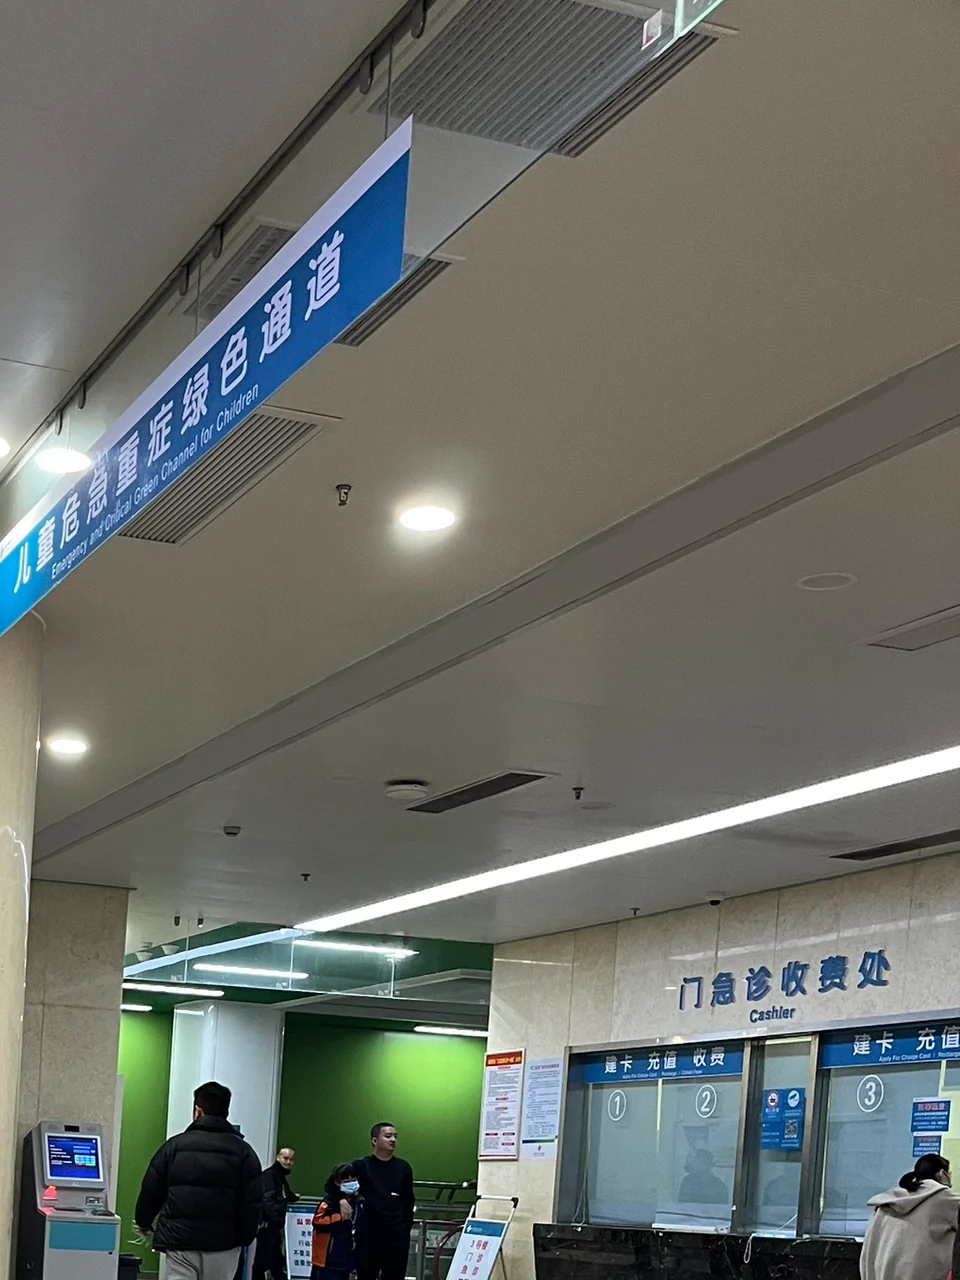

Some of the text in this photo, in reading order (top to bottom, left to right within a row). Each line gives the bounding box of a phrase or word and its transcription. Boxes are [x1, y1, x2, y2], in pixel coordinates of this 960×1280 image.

[14, 230, 345, 593] 儿童危急重症绿色通道
[52, 384, 259, 579] Emergency and Critical Green Channel for Children
[679, 950, 891, 1010] 门急诊收费处
[749, 1005, 796, 1023] Cashier
[604, 1046, 725, 1074] 建卡 充值 收费
[853, 1025, 960, 1056] 建卡 充值
